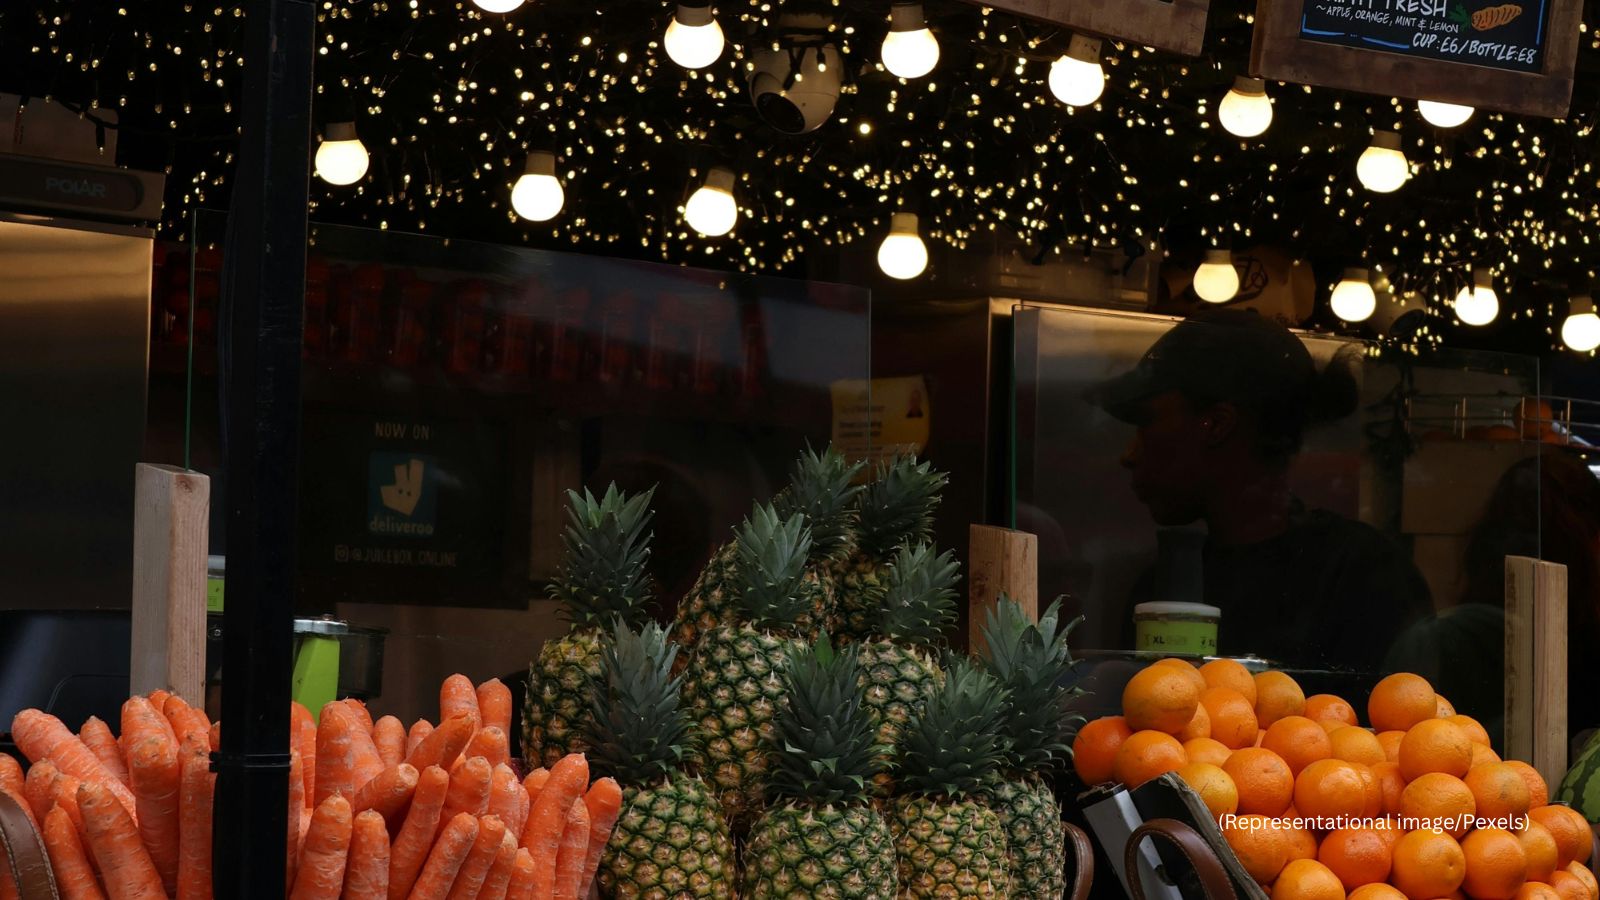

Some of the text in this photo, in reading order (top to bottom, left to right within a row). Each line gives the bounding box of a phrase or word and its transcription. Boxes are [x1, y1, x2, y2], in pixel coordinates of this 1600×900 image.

[1355, 10, 1392, 26] ORANGE,
[1395, 16, 1417, 27] MINT
[1417, 18, 1427, 31] &
[1429, 20, 1459, 33] LEMON
[46, 176, 106, 199] POLAR
[375, 422, 430, 440] NOW ON
[369, 515, 434, 536] deliveroo
